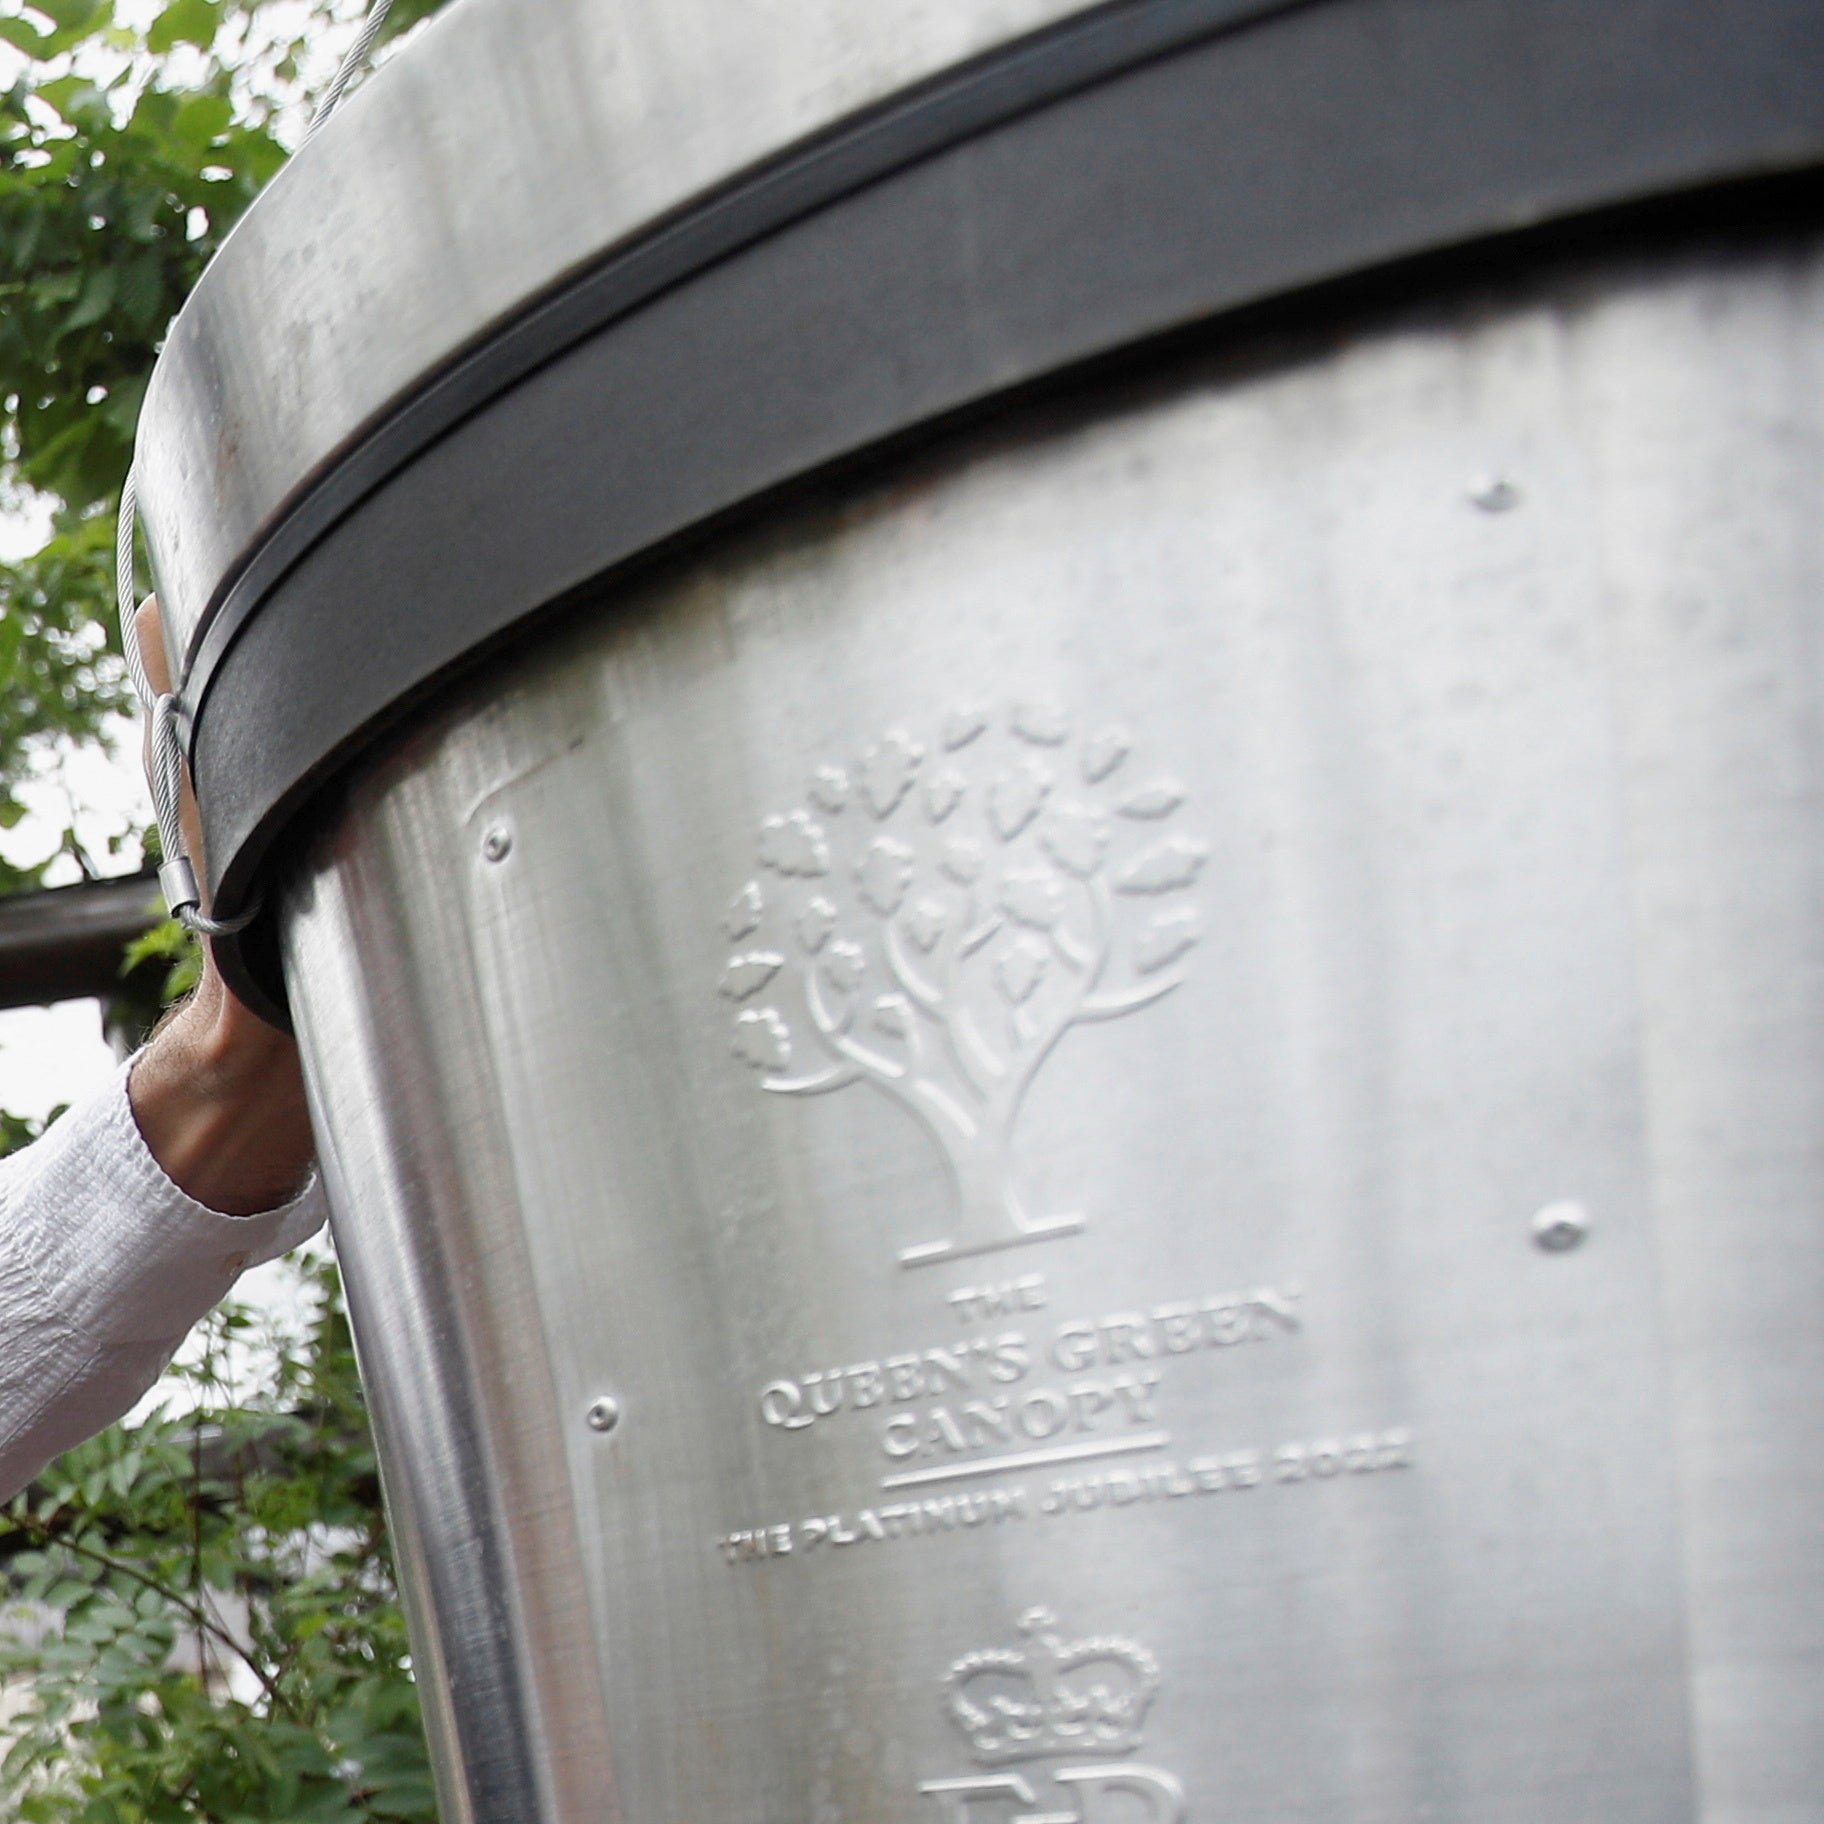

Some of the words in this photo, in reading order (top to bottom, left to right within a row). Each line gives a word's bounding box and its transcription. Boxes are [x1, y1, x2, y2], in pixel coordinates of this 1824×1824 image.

[947, 1271, 1048, 1325] THE
[1049, 1282, 1302, 1374] GREEN
[882, 1371, 1160, 1459] CANOPY
[717, 1522, 794, 1564] THE
[800, 1485, 1026, 1549] PLATINUM
[1042, 1449, 1262, 1516] JUBILEE
[1274, 1426, 1414, 1487] 2022
